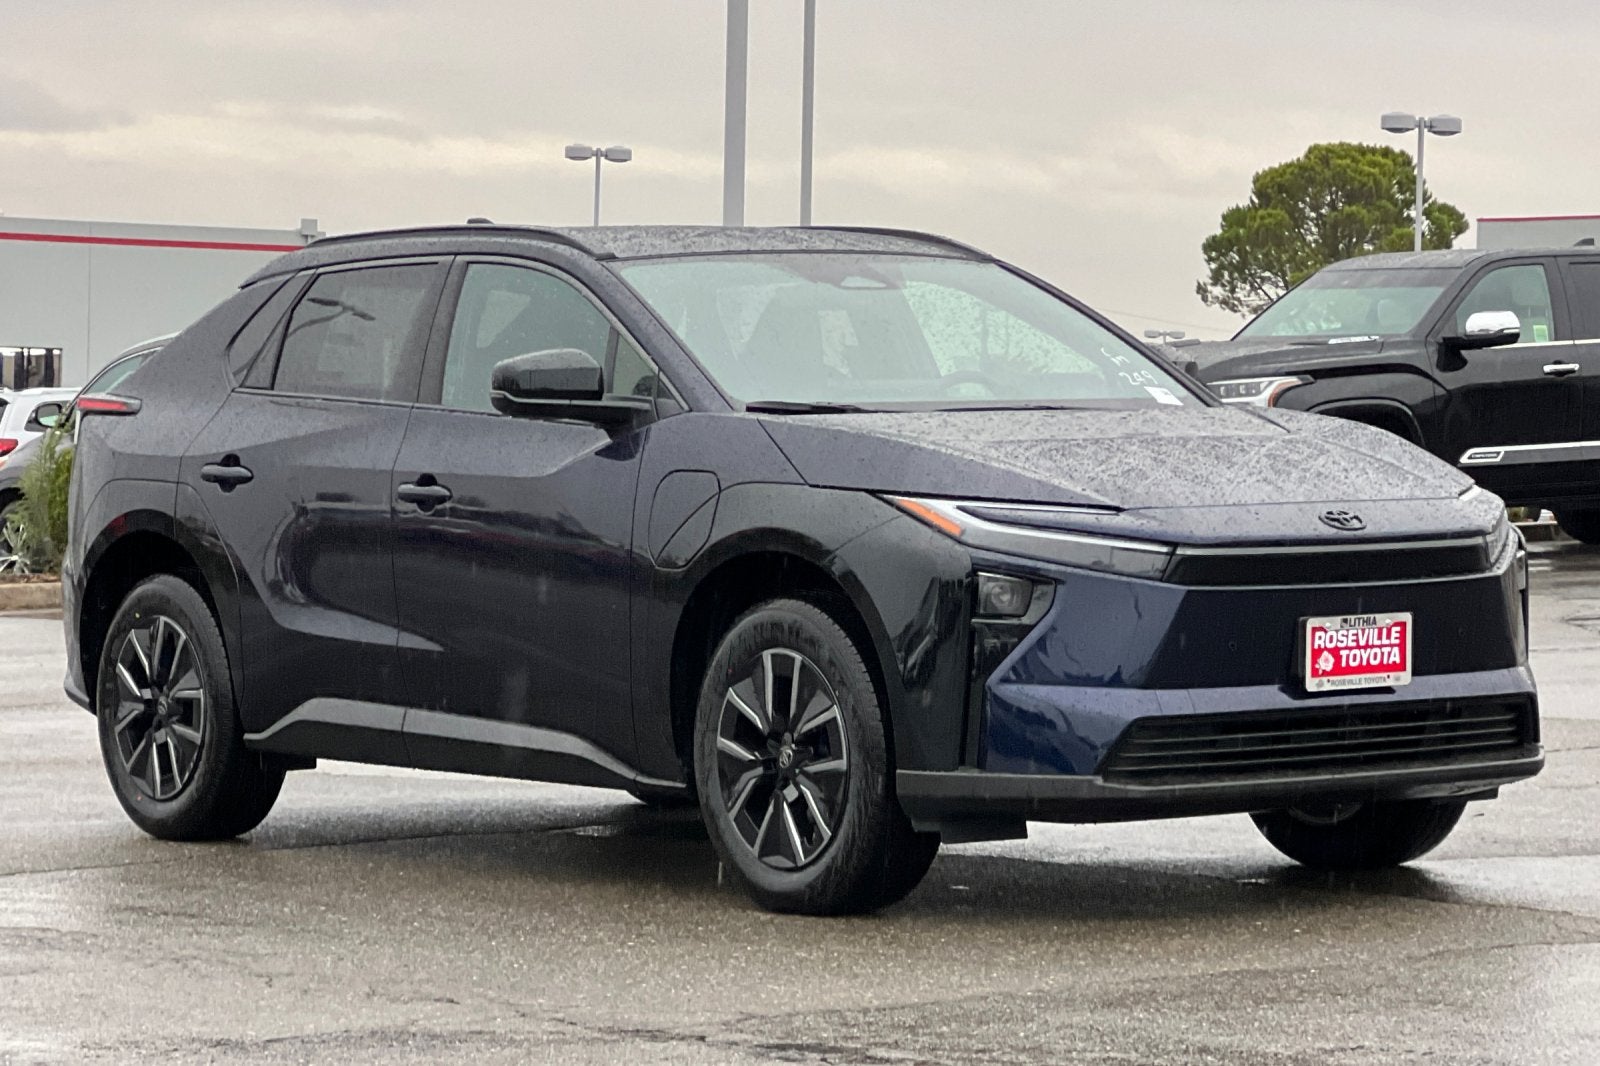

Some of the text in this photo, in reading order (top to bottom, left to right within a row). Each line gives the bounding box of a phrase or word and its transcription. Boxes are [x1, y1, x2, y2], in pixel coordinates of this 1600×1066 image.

[1348, 616, 1377, 628] LITHIA
[1314, 626, 1401, 649] ROSEVILLE
[1340, 646, 1400, 668] TOYOTA
[1330, 675, 1387, 686] ROSEVILLE TOYOTA
